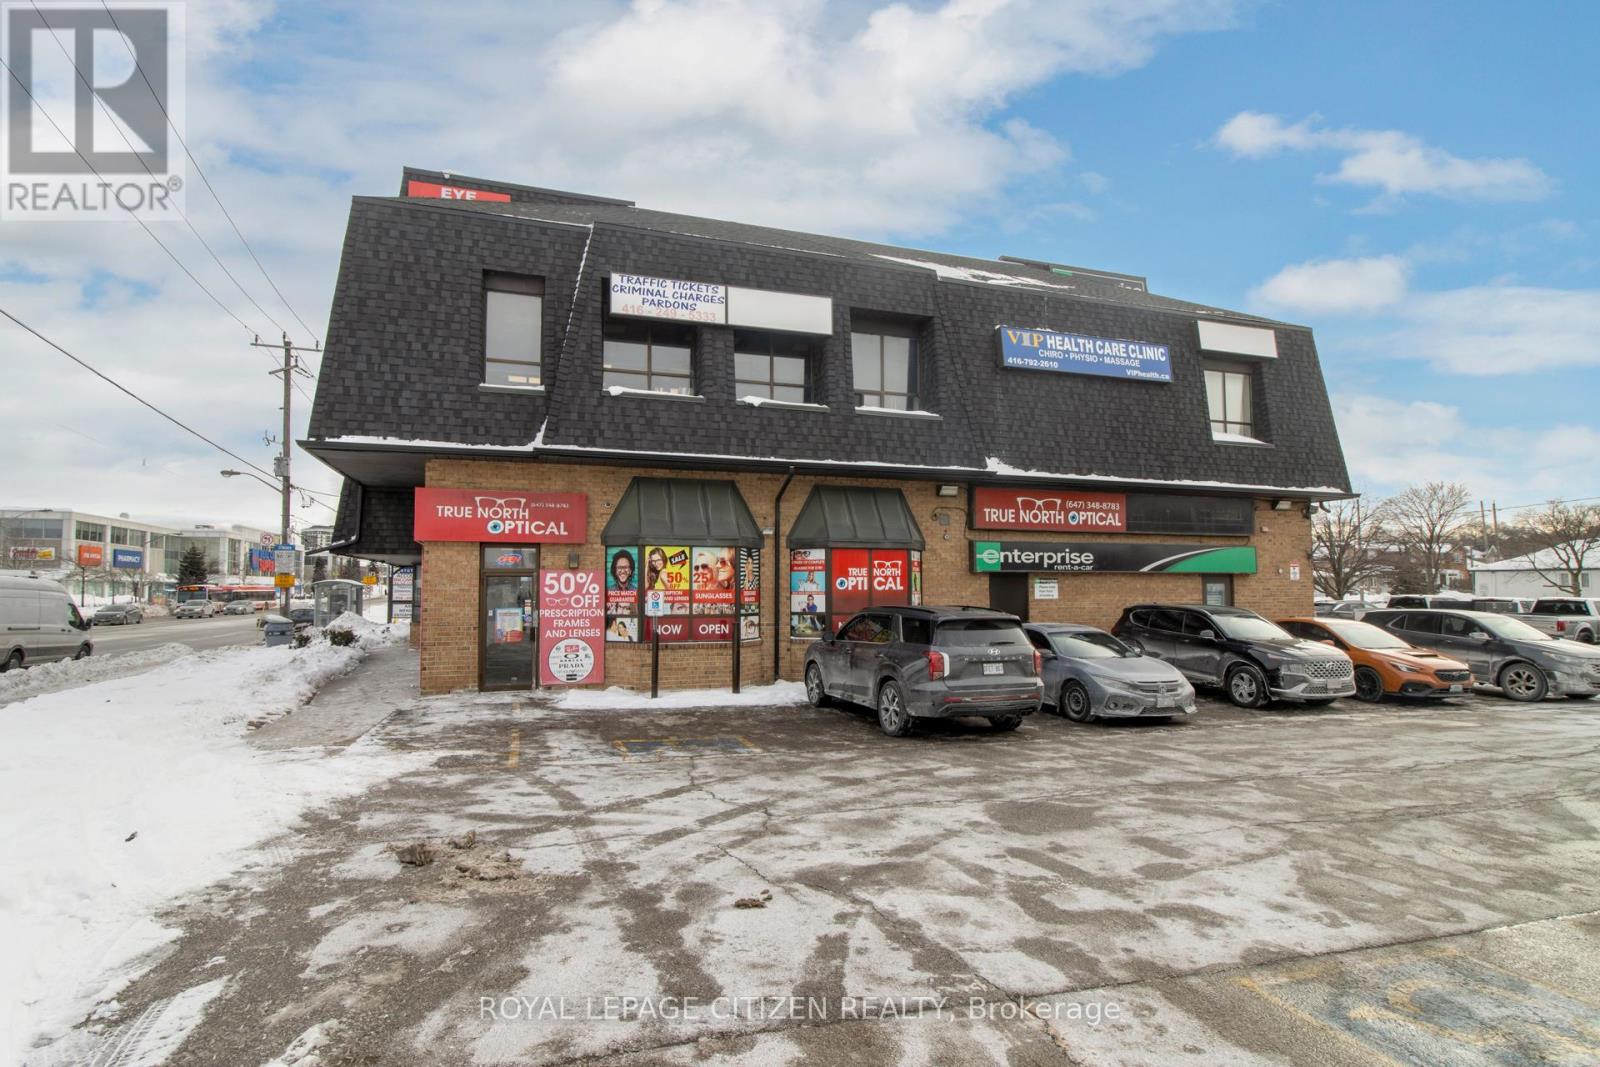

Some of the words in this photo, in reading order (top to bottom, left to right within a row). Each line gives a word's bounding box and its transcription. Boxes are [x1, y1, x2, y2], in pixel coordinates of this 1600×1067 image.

[441, 186, 477, 200] EYE
[619, 274, 667, 289] TRAFFIC
[671, 280, 719, 294] TICKETS
[612, 284, 669, 299] CRIMINAL
[672, 291, 725, 304] CHARGES
[642, 298, 697, 311] PARDONS
[1007, 330, 1044, 348] VIP
[1046, 335, 1094, 354] HEALTH
[1095, 341, 1127, 357] CARE
[1128, 344, 1166, 362] CLINIC
[1038, 349, 1064, 359] CHIRO
[1069, 352, 1098, 363] PHYSIO
[1104, 356, 1141, 368] MASSAGE
[436, 505, 472, 518] TRUE
[477, 507, 529, 520] NORTH
[1066, 500, 1085, 510] (647)
[1086, 501, 1120, 511] 348-8783
[983, 508, 1016, 523] TRUE
[1019, 510, 1065, 524] NORTH
[1068, 510, 1121, 526] OPTICAL
[487, 519, 568, 536] OPTICAL
[671, 553, 686, 564] SALE
[981, 548, 1094, 568] enterprise
[848, 567, 868, 577] TRUE
[873, 567, 901, 577] NORTH
[1054, 563, 1094, 571] rent-a-car
[543, 572, 600, 595] 50%
[570, 594, 600, 608] OFF
[539, 608, 604, 618] PRESCRIPTION
[553, 618, 591, 628] FRAMES
[698, 624, 729, 635] OPEN
[545, 629, 567, 638] AND
[569, 629, 601, 637] LENSES
